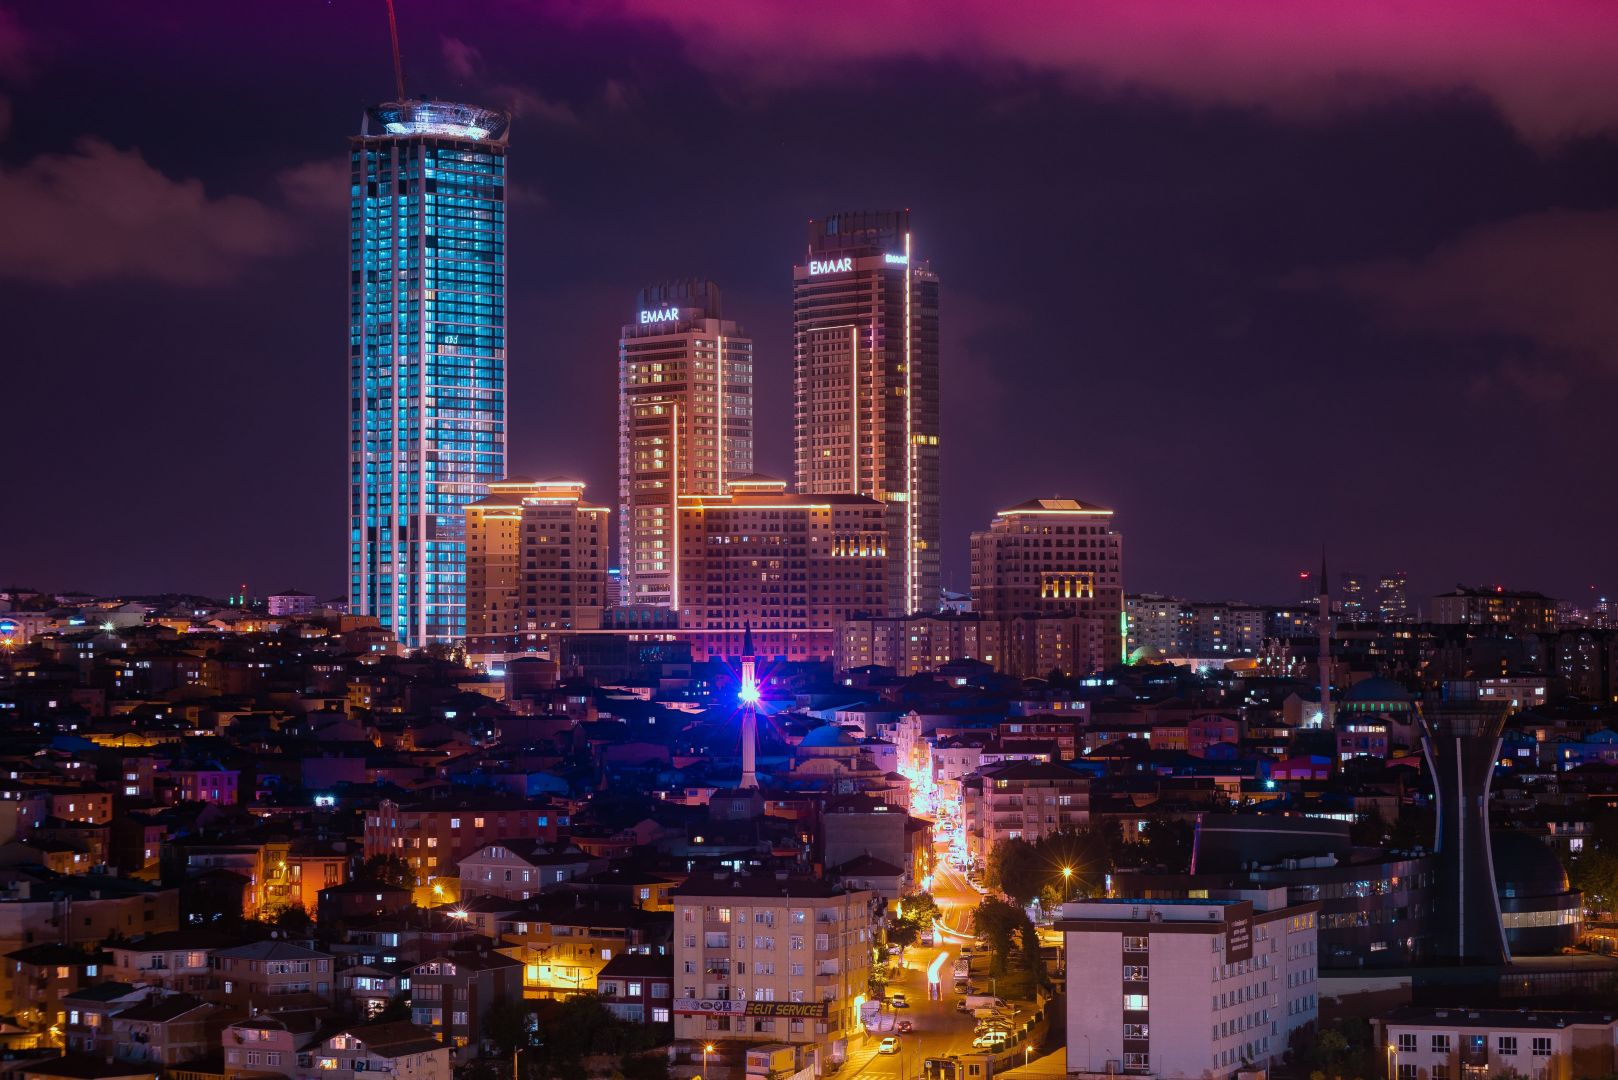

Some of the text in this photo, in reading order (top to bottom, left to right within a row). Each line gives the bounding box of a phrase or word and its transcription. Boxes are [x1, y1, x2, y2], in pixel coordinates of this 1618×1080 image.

[810, 258, 852, 275] EMAAR
[641, 308, 680, 323] EMAAR
[776, 1004, 817, 1016] SERVICE
